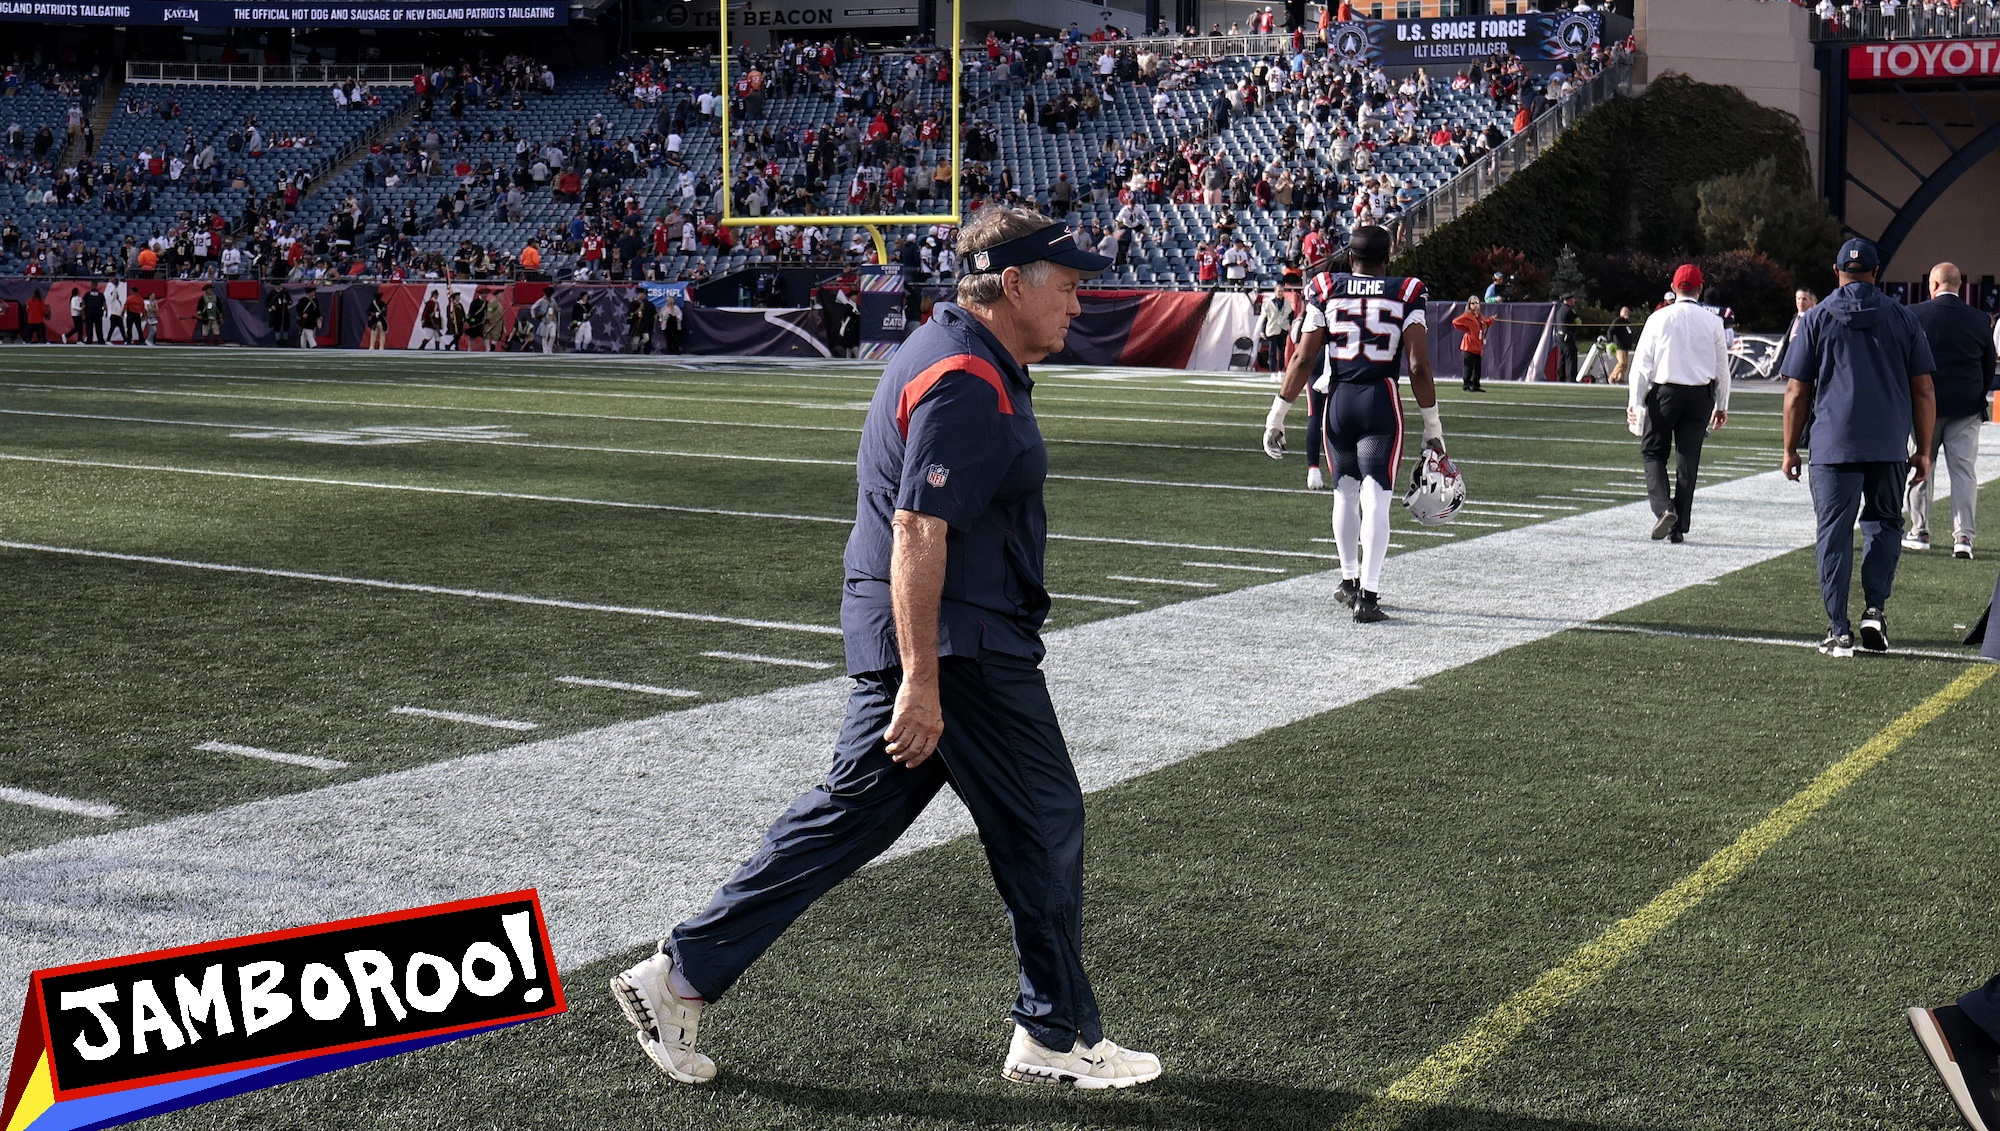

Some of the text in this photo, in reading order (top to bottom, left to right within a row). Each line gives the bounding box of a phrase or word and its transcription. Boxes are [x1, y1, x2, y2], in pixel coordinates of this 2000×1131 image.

[34, 3, 78, 16] PATRIOTS
[79, 5, 130, 18] TAILGATING
[164, 9, 199, 21] KAYEM
[234, 7, 555, 20] THE OFFICIAL HOT DOG AND SAUSAGE OF NEW ENGLAND PATRIOTS TAILGATING
[692, 9, 833, 26] THE BEACON
[1396, 19, 1527, 42] U.S. SPACE FORCE
[1430, 43, 1467, 58] LESLEY
[1468, 42, 1508, 57] DALGER
[1347, 279, 1385, 295] UCHE
[1324, 298, 1405, 361] 55
